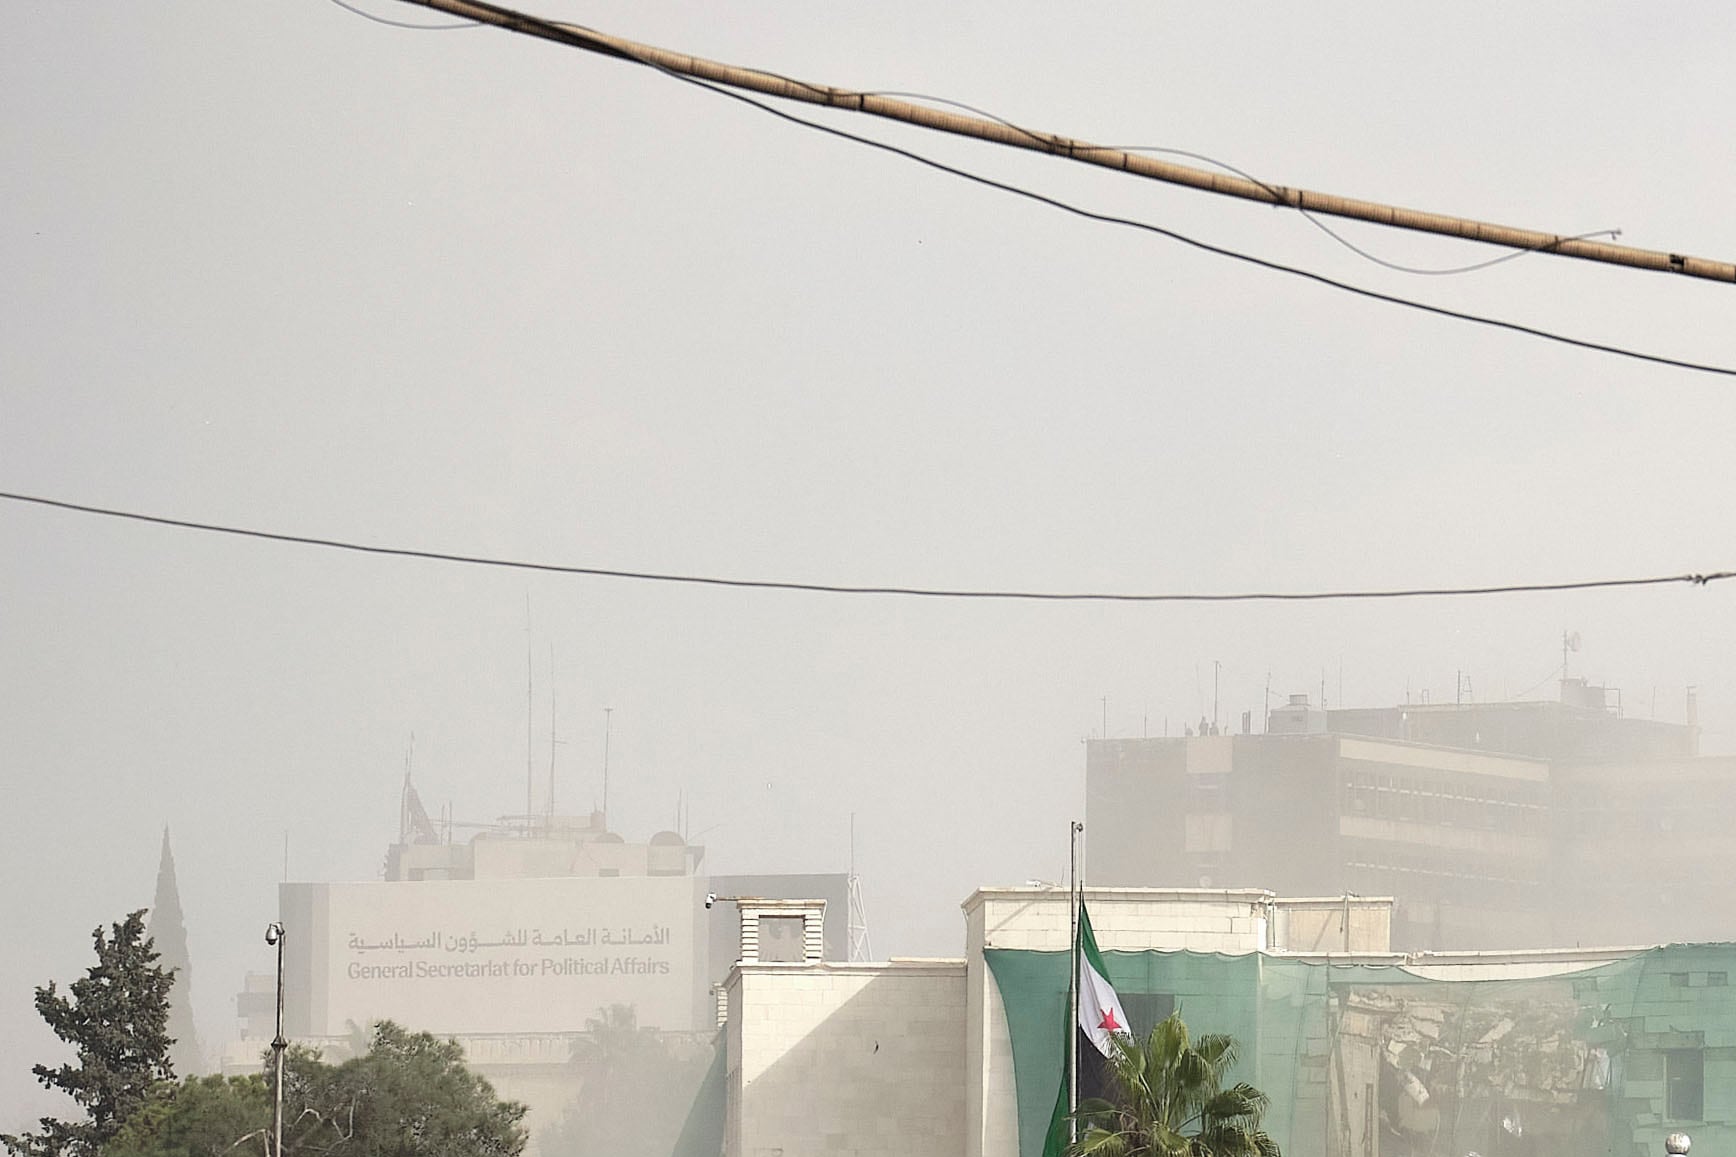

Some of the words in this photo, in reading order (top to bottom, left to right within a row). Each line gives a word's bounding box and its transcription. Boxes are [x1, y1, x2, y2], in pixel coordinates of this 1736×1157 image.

[348, 930, 441, 954] السياسية
[445, 928, 527, 953] للشؤون
[532, 928, 597, 947] العامة
[601, 923, 670, 946] الأمانة
[347, 960, 413, 980] General
[415, 959, 510, 978] Secretariat
[513, 958, 538, 977] for
[541, 957, 608, 977] Political
[610, 956, 670, 976] Affairs
